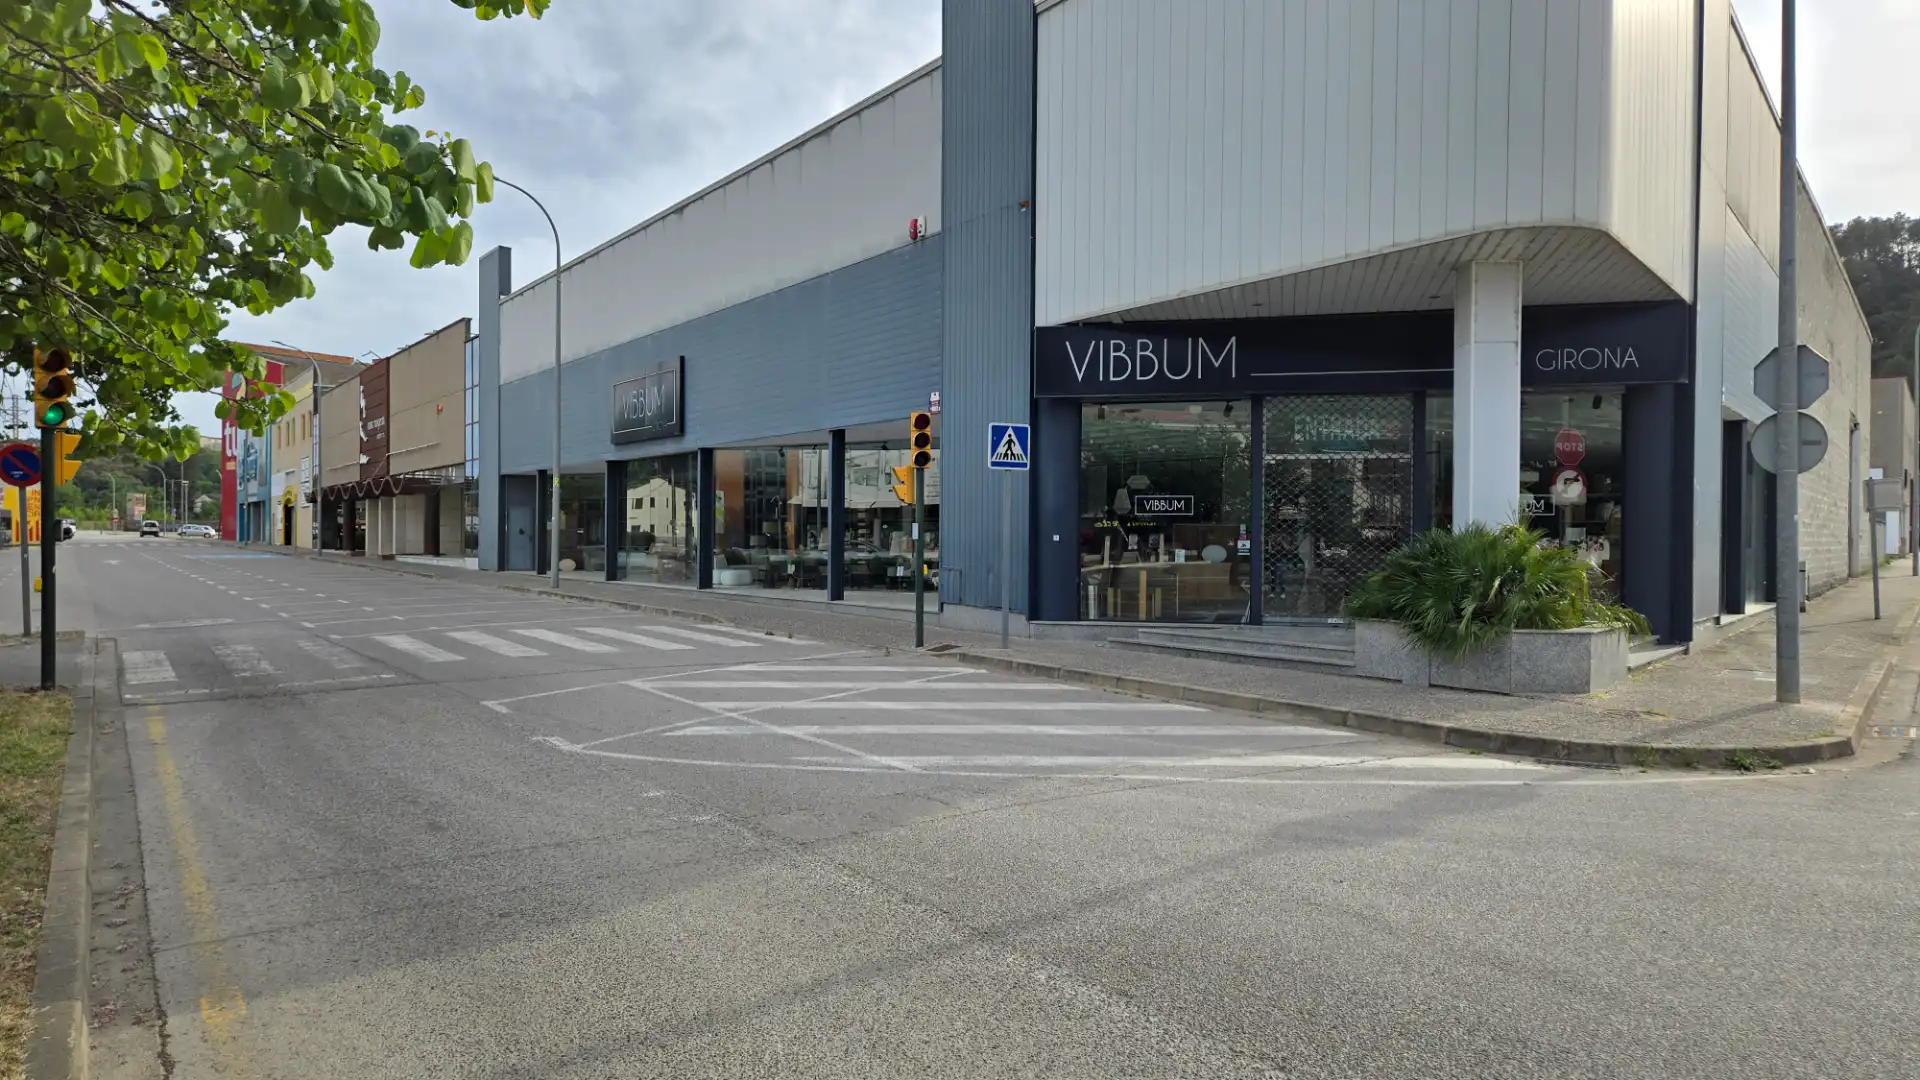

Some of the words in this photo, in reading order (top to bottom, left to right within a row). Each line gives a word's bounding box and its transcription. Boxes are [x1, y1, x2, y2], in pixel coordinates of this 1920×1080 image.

[1066, 336, 1236, 382] VIBBUM
[1536, 346, 1639, 371] GIRONA
[622, 384, 665, 419] VIBBUM
[1144, 500, 1185, 511] VIBBUM
